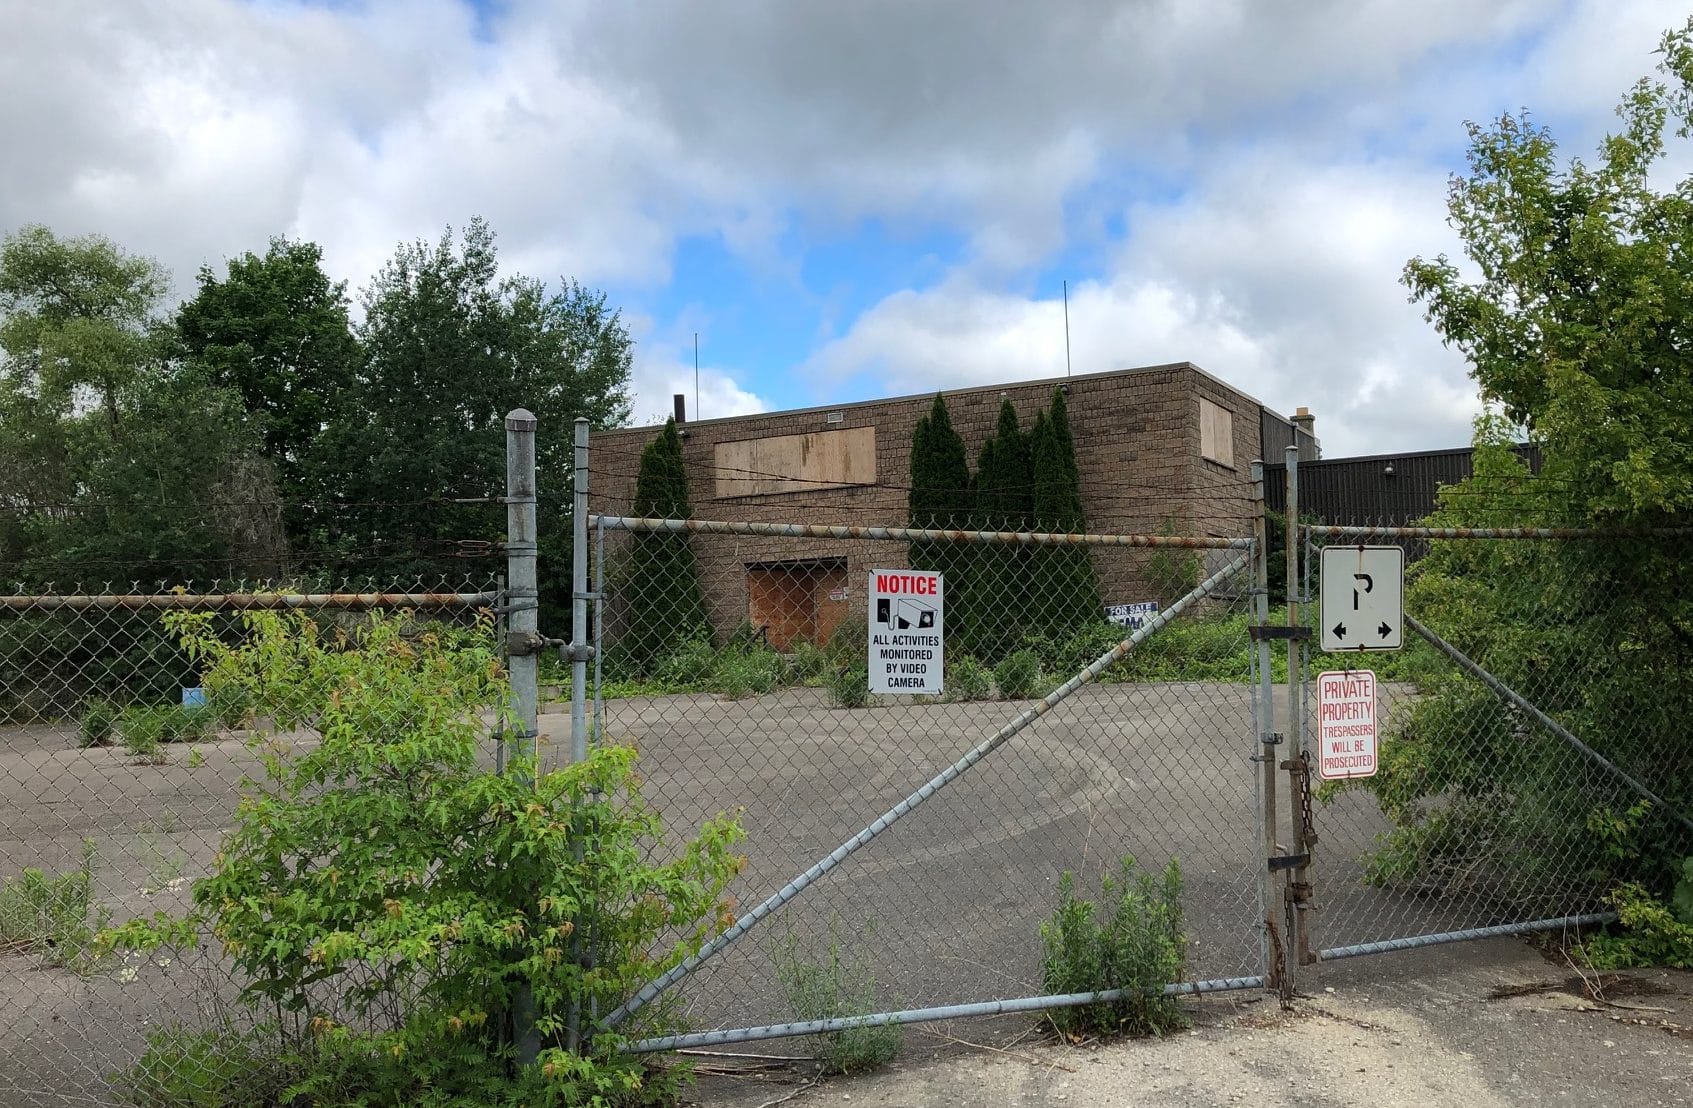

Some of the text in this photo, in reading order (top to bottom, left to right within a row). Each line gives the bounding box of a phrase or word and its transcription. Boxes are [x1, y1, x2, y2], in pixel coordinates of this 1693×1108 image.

[877, 575, 937, 595] NOTICE
[1110, 603, 1152, 616] FOR SALE
[873, 635, 939, 647] ALL ACTIVITIES
[880, 649, 933, 660] MONITORED
[886, 663, 927, 674] BY VIDEO
[888, 677, 925, 688] CAMERA
[1324, 679, 1371, 699] PRIVATE
[1322, 701, 1372, 721] PROPERTY
[1324, 724, 1373, 739] TRESPASSERS
[1332, 739, 1365, 753] WILL BE
[1324, 755, 1373, 769] PROSECUTED
